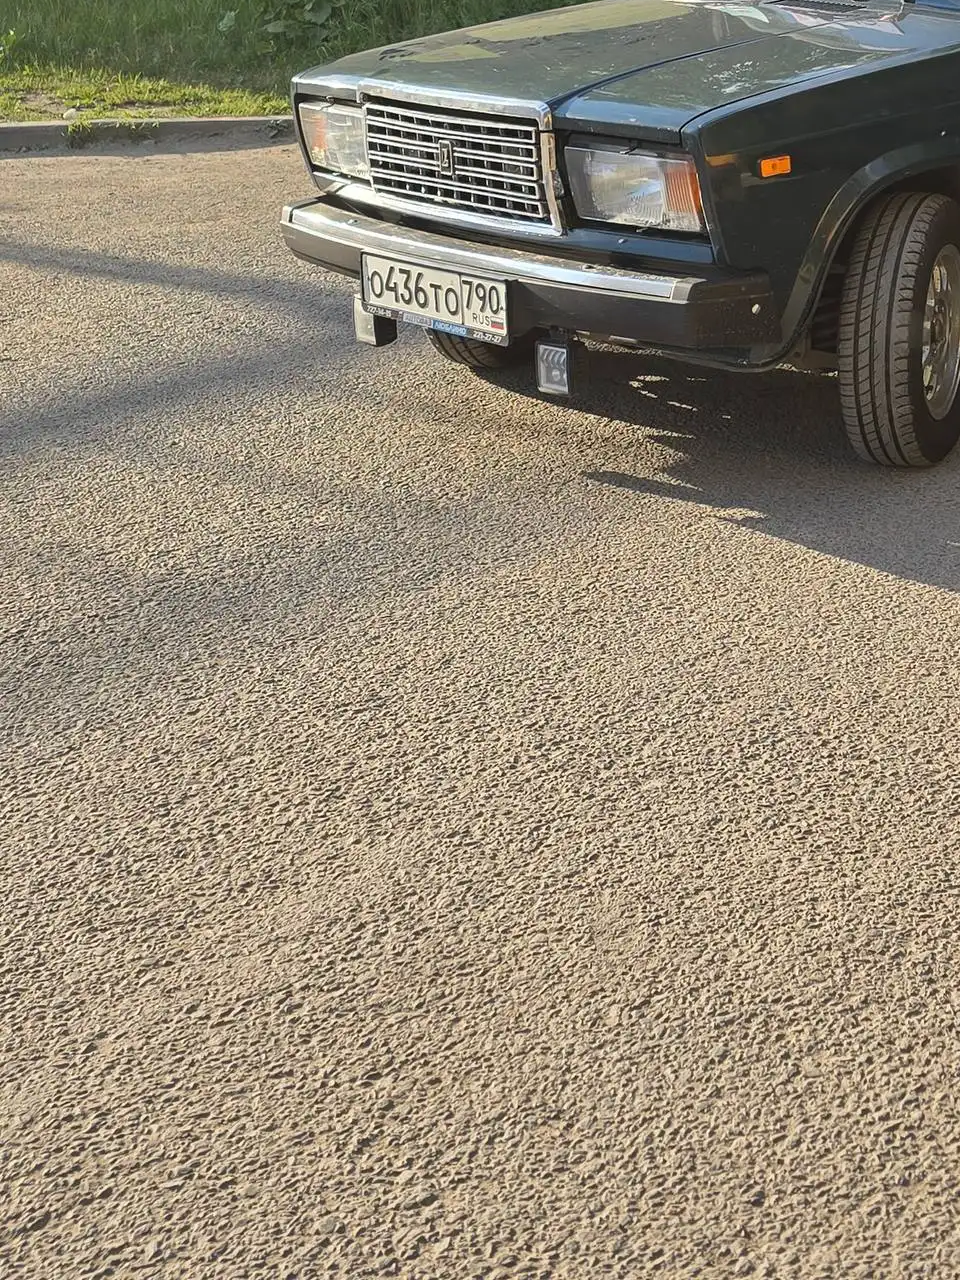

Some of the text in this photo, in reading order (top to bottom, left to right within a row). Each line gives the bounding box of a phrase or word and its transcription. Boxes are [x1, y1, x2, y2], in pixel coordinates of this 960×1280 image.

[370, 266, 500, 316] О436ТО 790
[472, 313, 491, 326] RUS
